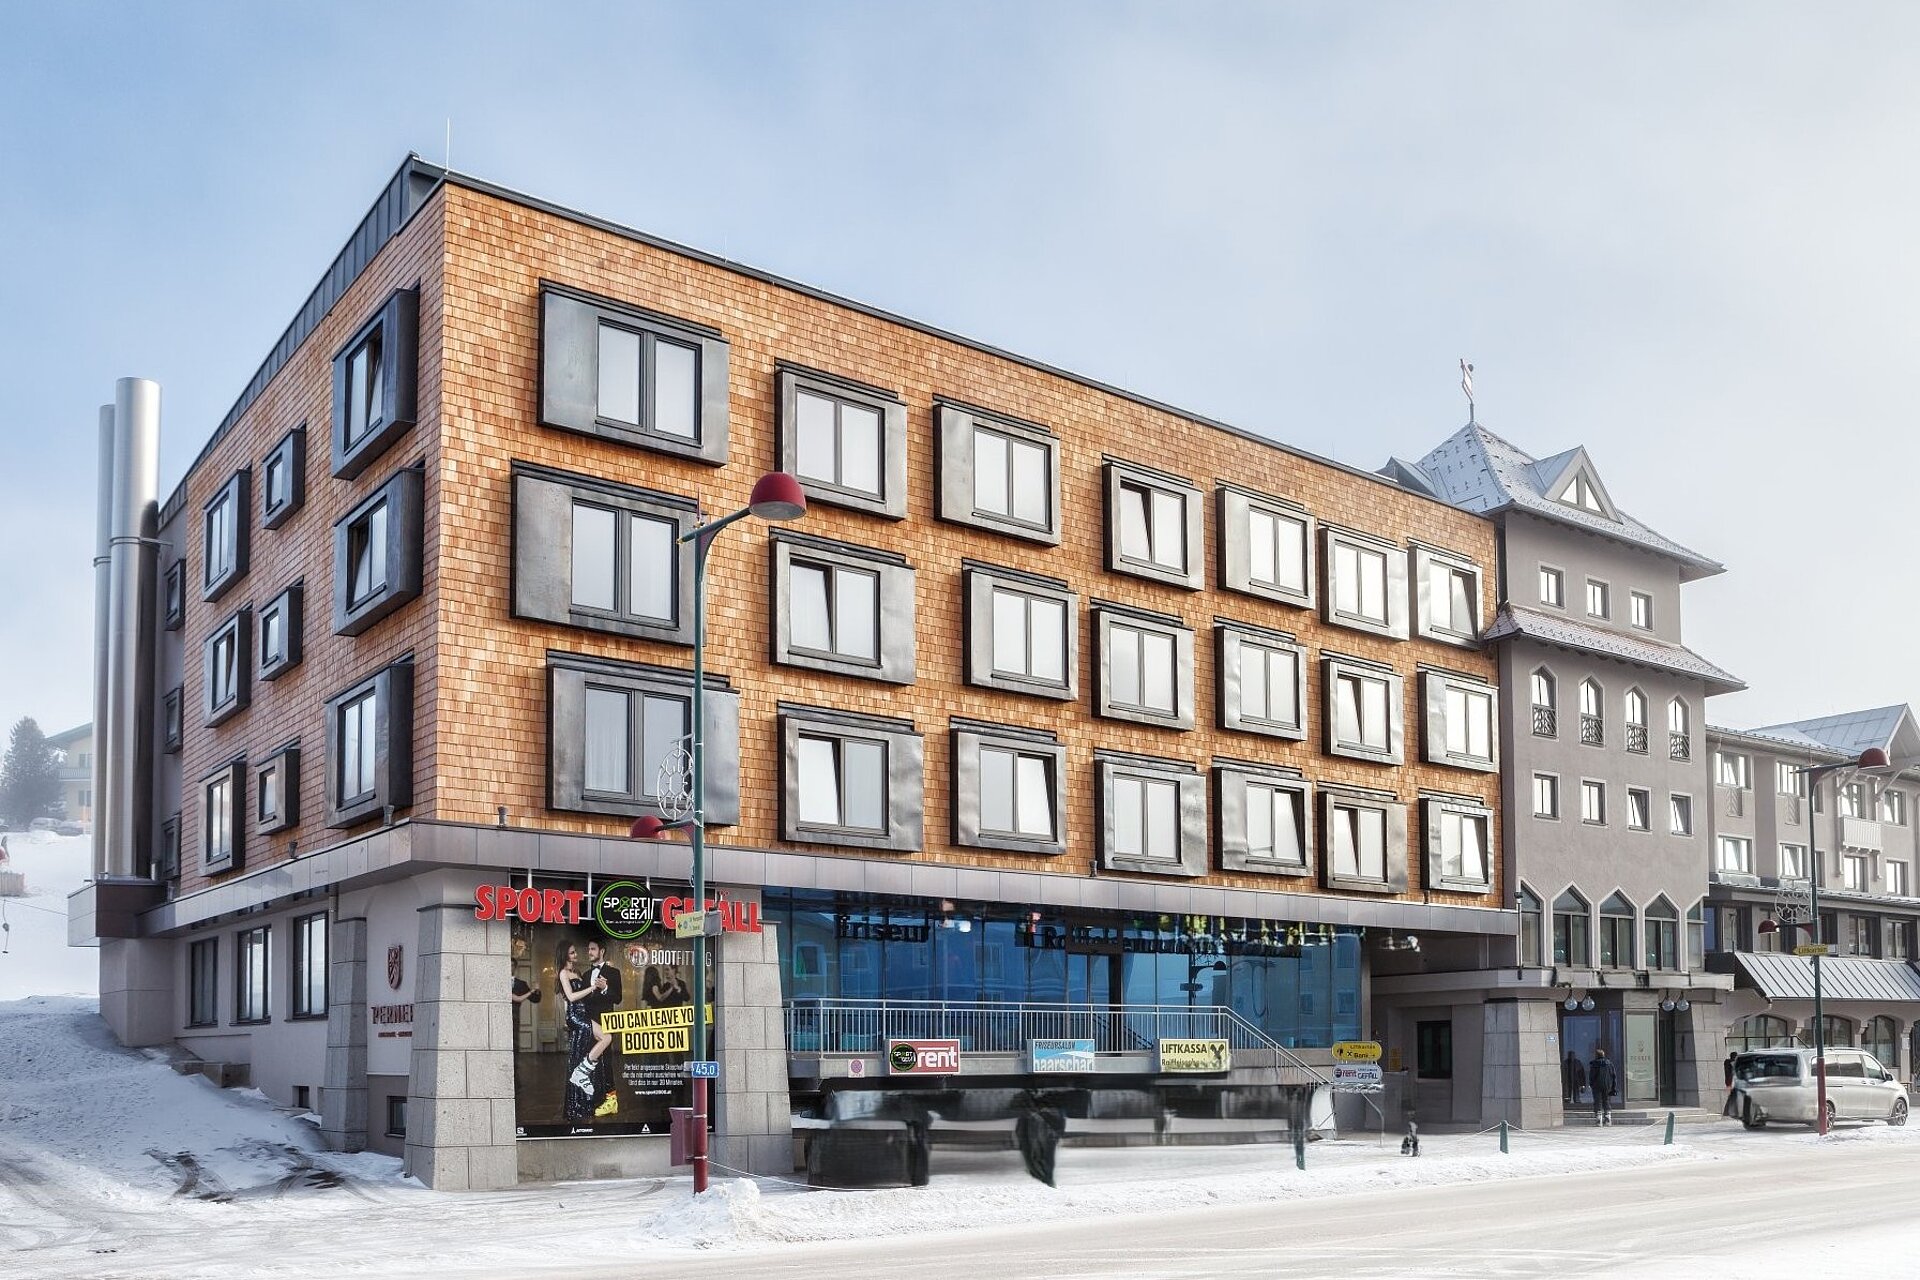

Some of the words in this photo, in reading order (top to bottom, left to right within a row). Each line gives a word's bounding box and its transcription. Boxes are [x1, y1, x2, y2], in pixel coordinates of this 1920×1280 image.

[475, 884, 584, 924] SPORT
[662, 889, 762, 933] GÄLL
[651, 949, 712, 967] BOOTFITTG
[604, 1014, 624, 1031] YOU
[627, 1011, 648, 1028] CAN
[650, 1009, 679, 1026] LEAVE
[681, 1007, 708, 1023] YO
[625, 1031, 665, 1051] BOOTS
[667, 1030, 684, 1049] ON
[1035, 1041, 1076, 1050] FRISEURSALON
[1162, 1043, 1207, 1054] LIFTKASSA
[917, 1046, 957, 1068] rent
